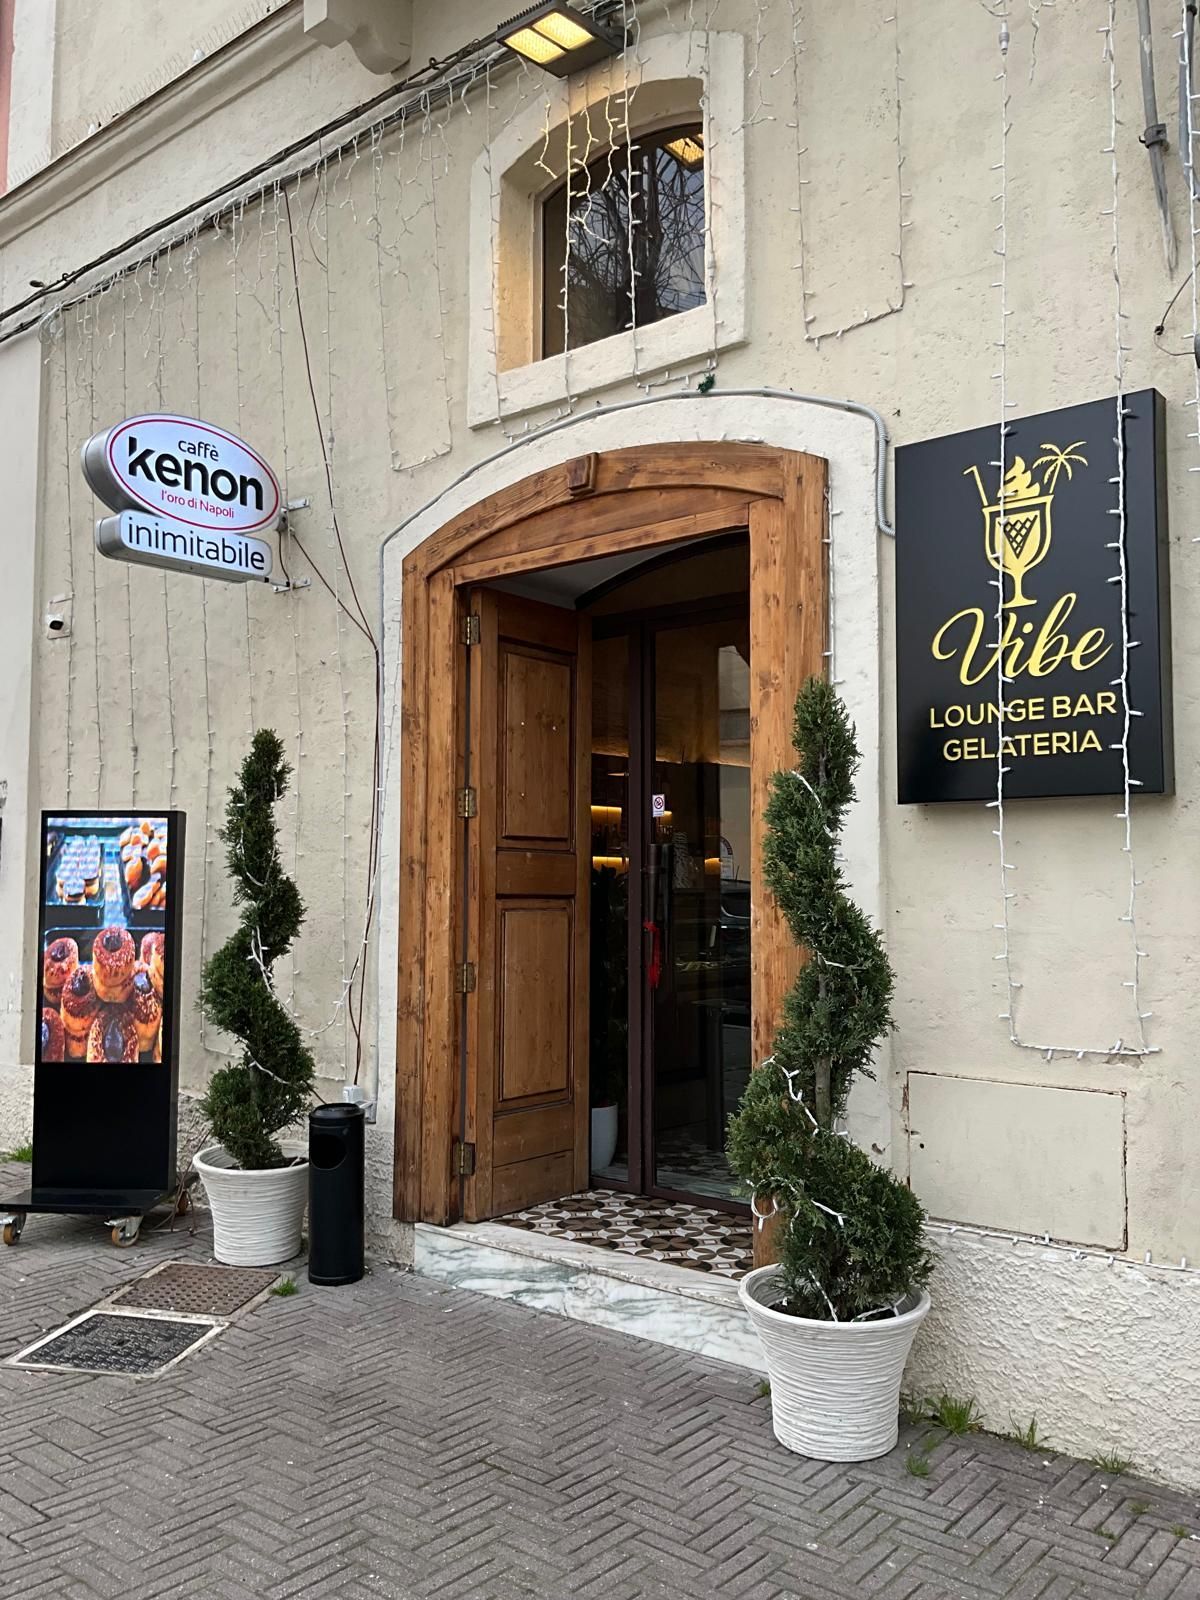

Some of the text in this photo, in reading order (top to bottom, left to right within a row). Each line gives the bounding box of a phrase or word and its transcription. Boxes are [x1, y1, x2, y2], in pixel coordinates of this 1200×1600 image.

[178, 439, 219, 461] caffè
[128, 436, 264, 511] kenon
[161, 489, 234, 518] l'oro di Napoli
[129, 517, 265, 570] inimitabile
[931, 592, 1114, 686] Vibe
[930, 691, 1117, 728] LOUNGE BAR
[943, 729, 1102, 761] GELATERIA
